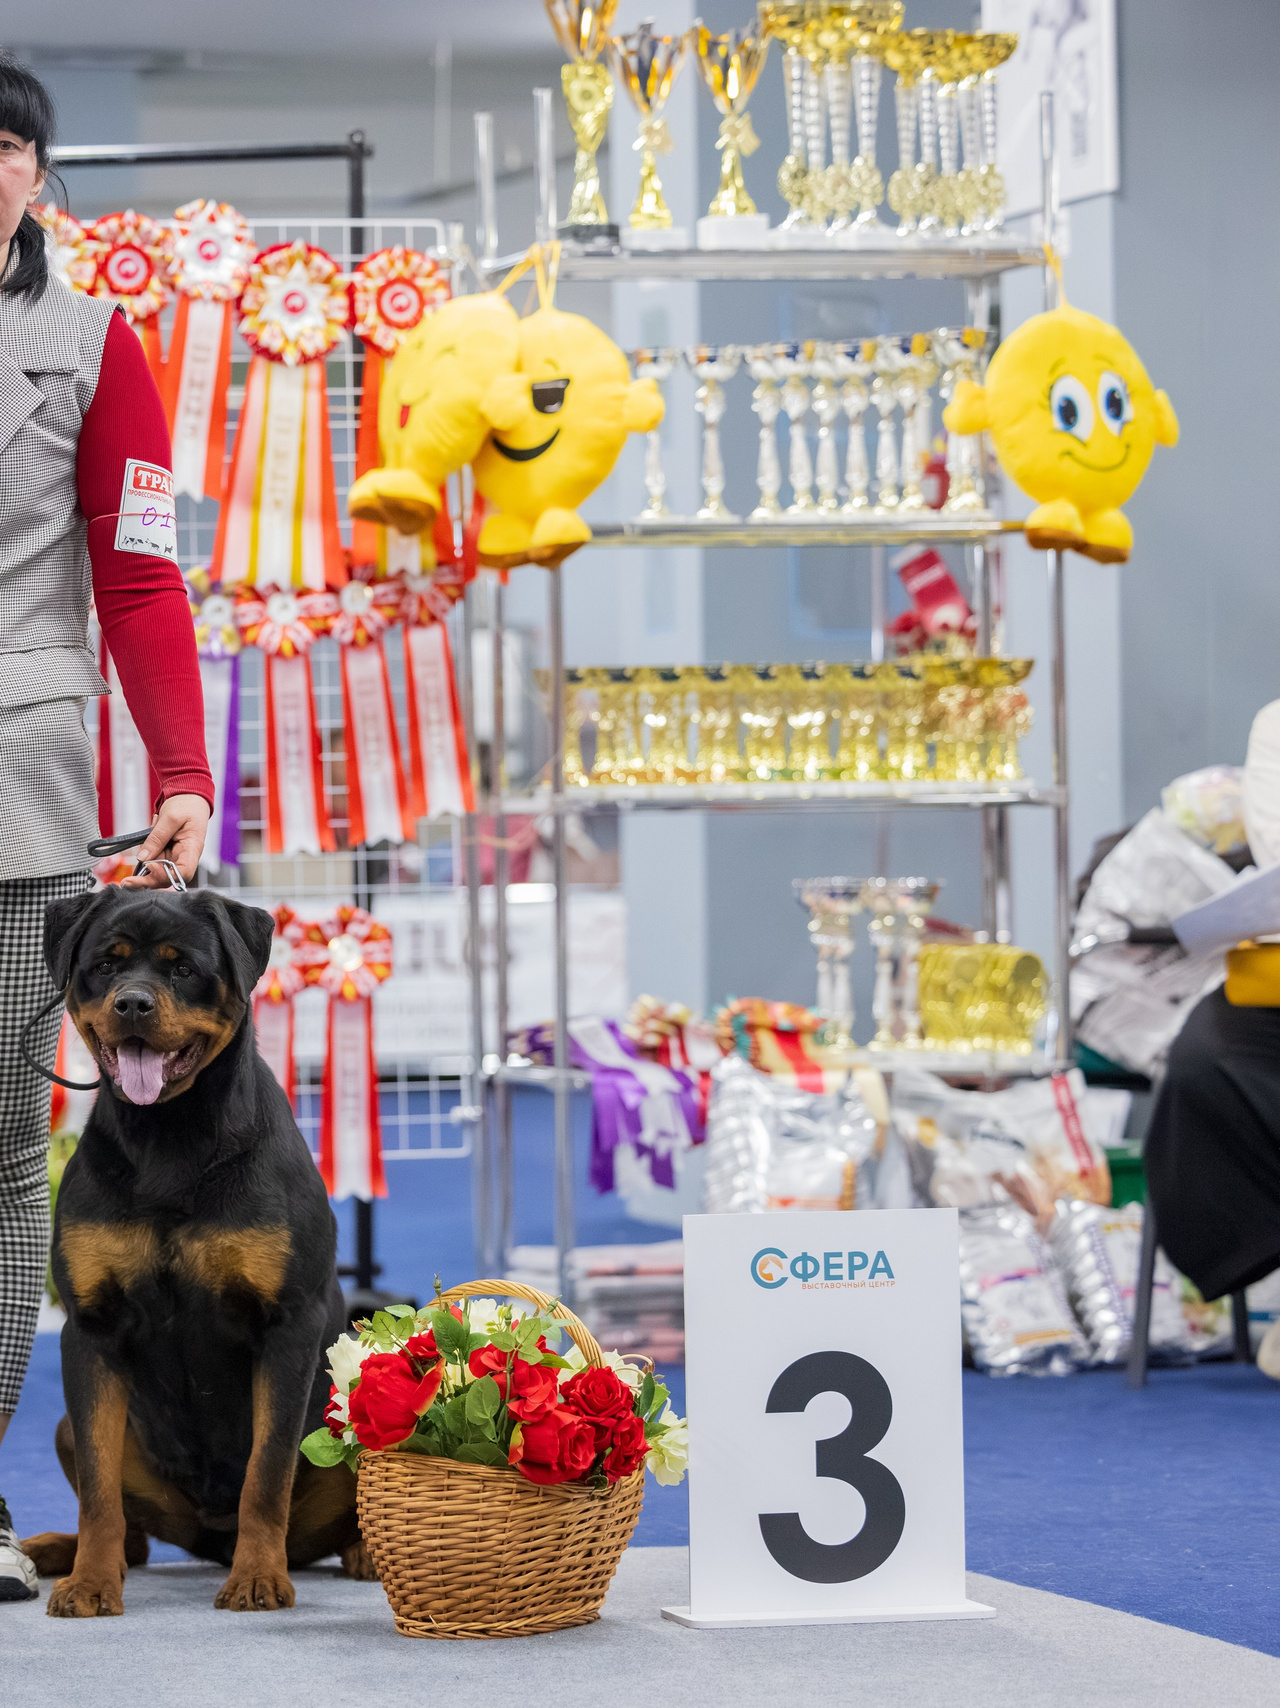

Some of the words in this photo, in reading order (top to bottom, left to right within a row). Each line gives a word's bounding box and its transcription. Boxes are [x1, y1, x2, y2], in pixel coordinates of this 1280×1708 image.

[750, 1247, 895, 1290] СФЕРА
[801, 1281, 866, 1290] ВЫСТАВОЧНЫЙ
[868, 1280, 896, 1288] ЦЕНТР
[758, 1350, 906, 1585] 3
